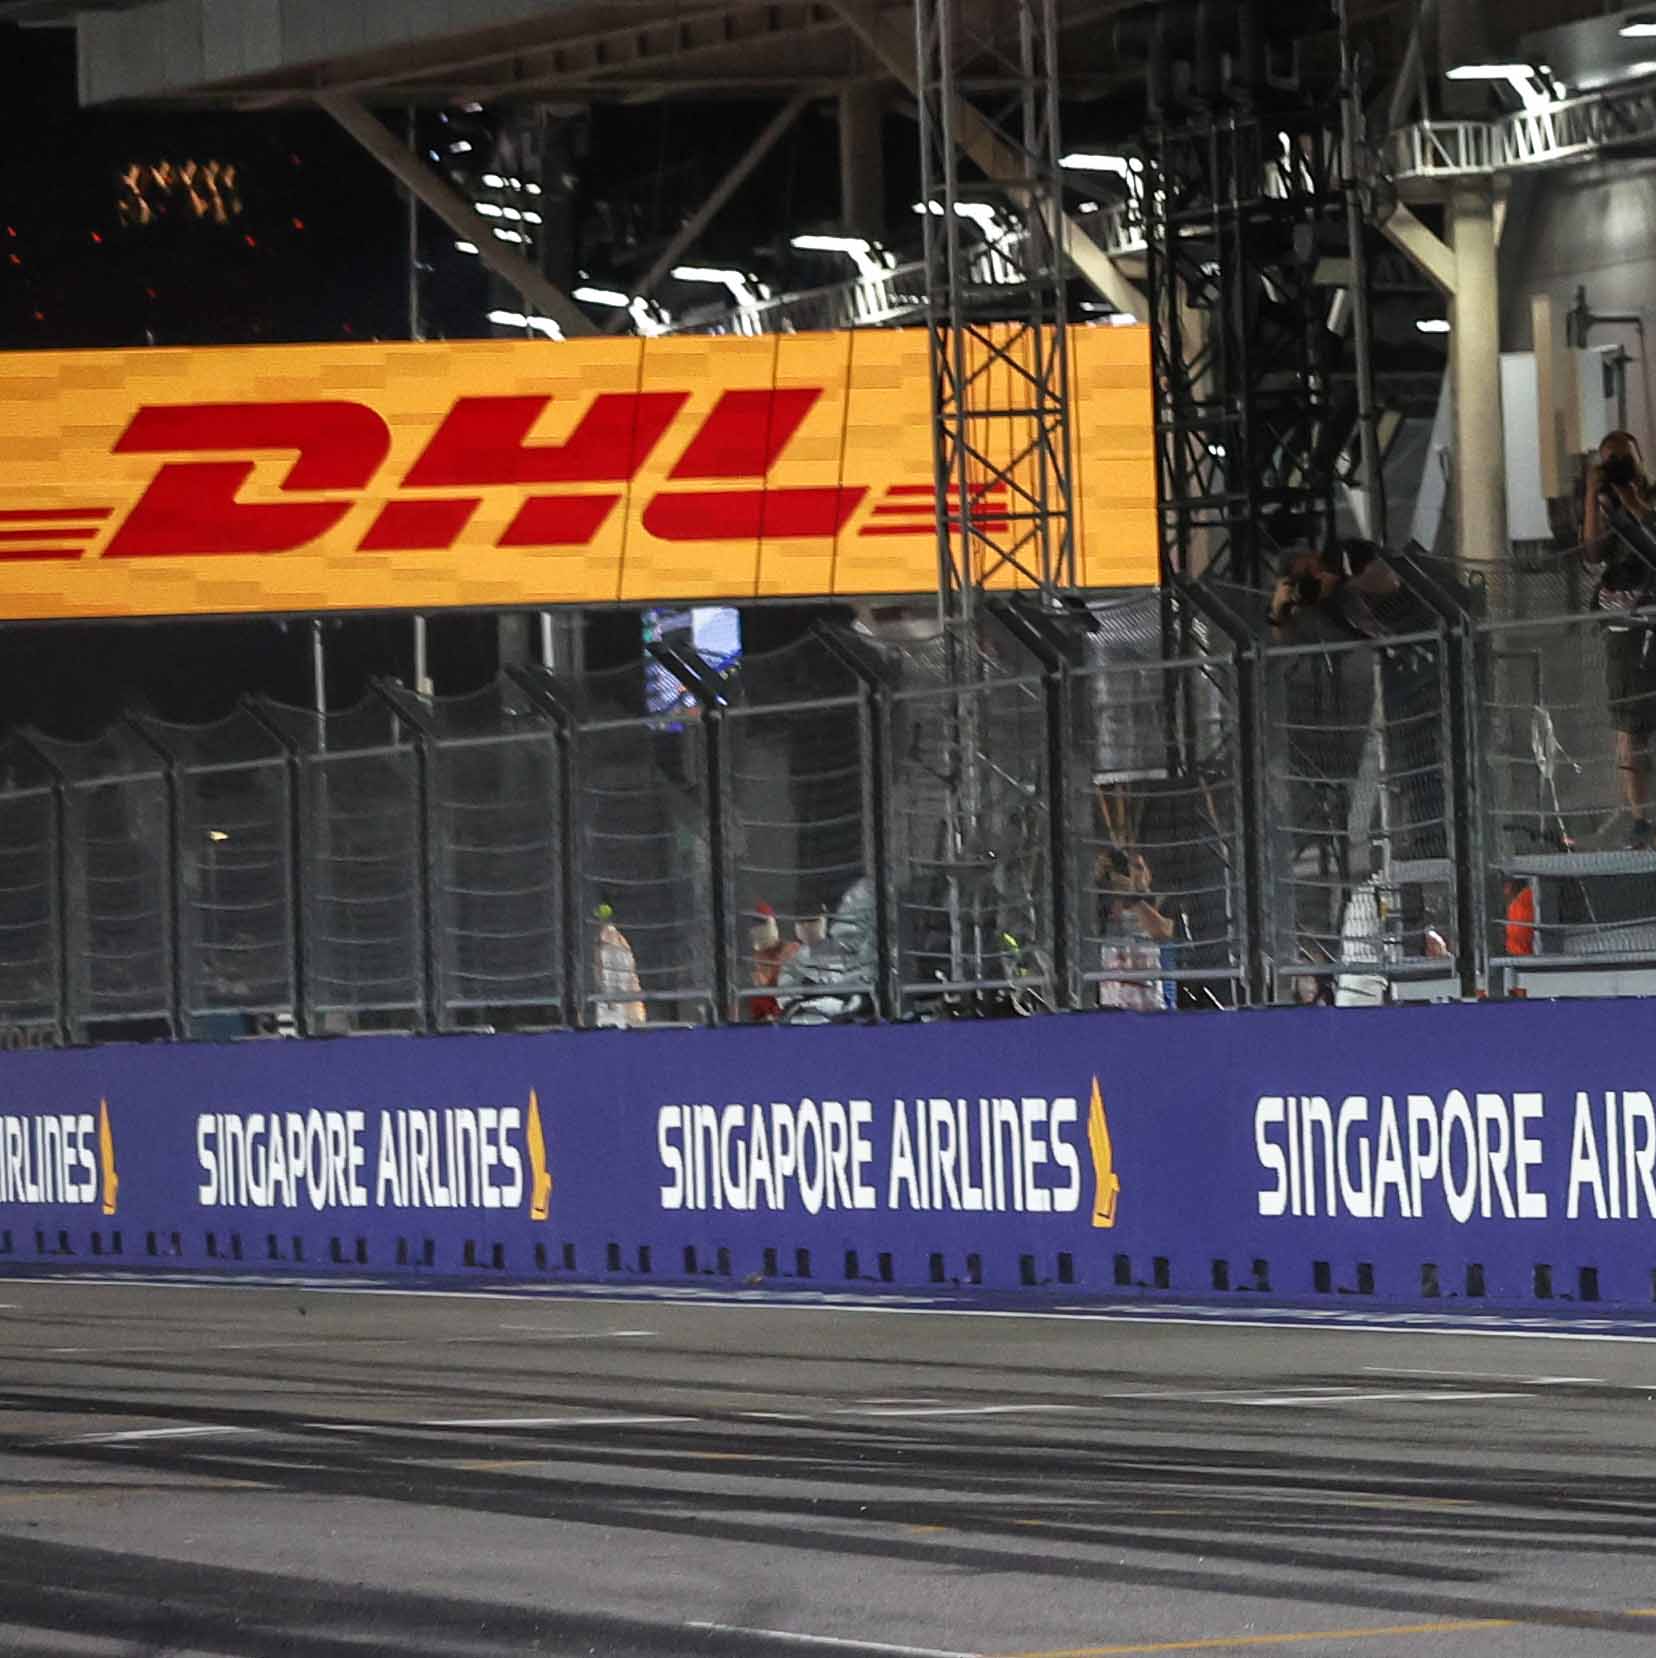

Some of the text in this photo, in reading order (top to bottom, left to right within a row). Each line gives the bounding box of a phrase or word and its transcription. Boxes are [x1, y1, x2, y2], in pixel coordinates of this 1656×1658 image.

[100, 387, 869, 560] DHL
[196, 1106, 524, 1211] SINGAPORE AIRLINES
[657, 1097, 1081, 1215] SINGAPORE AIRLINES
[1254, 1088, 1548, 1224] SINGAPORE
